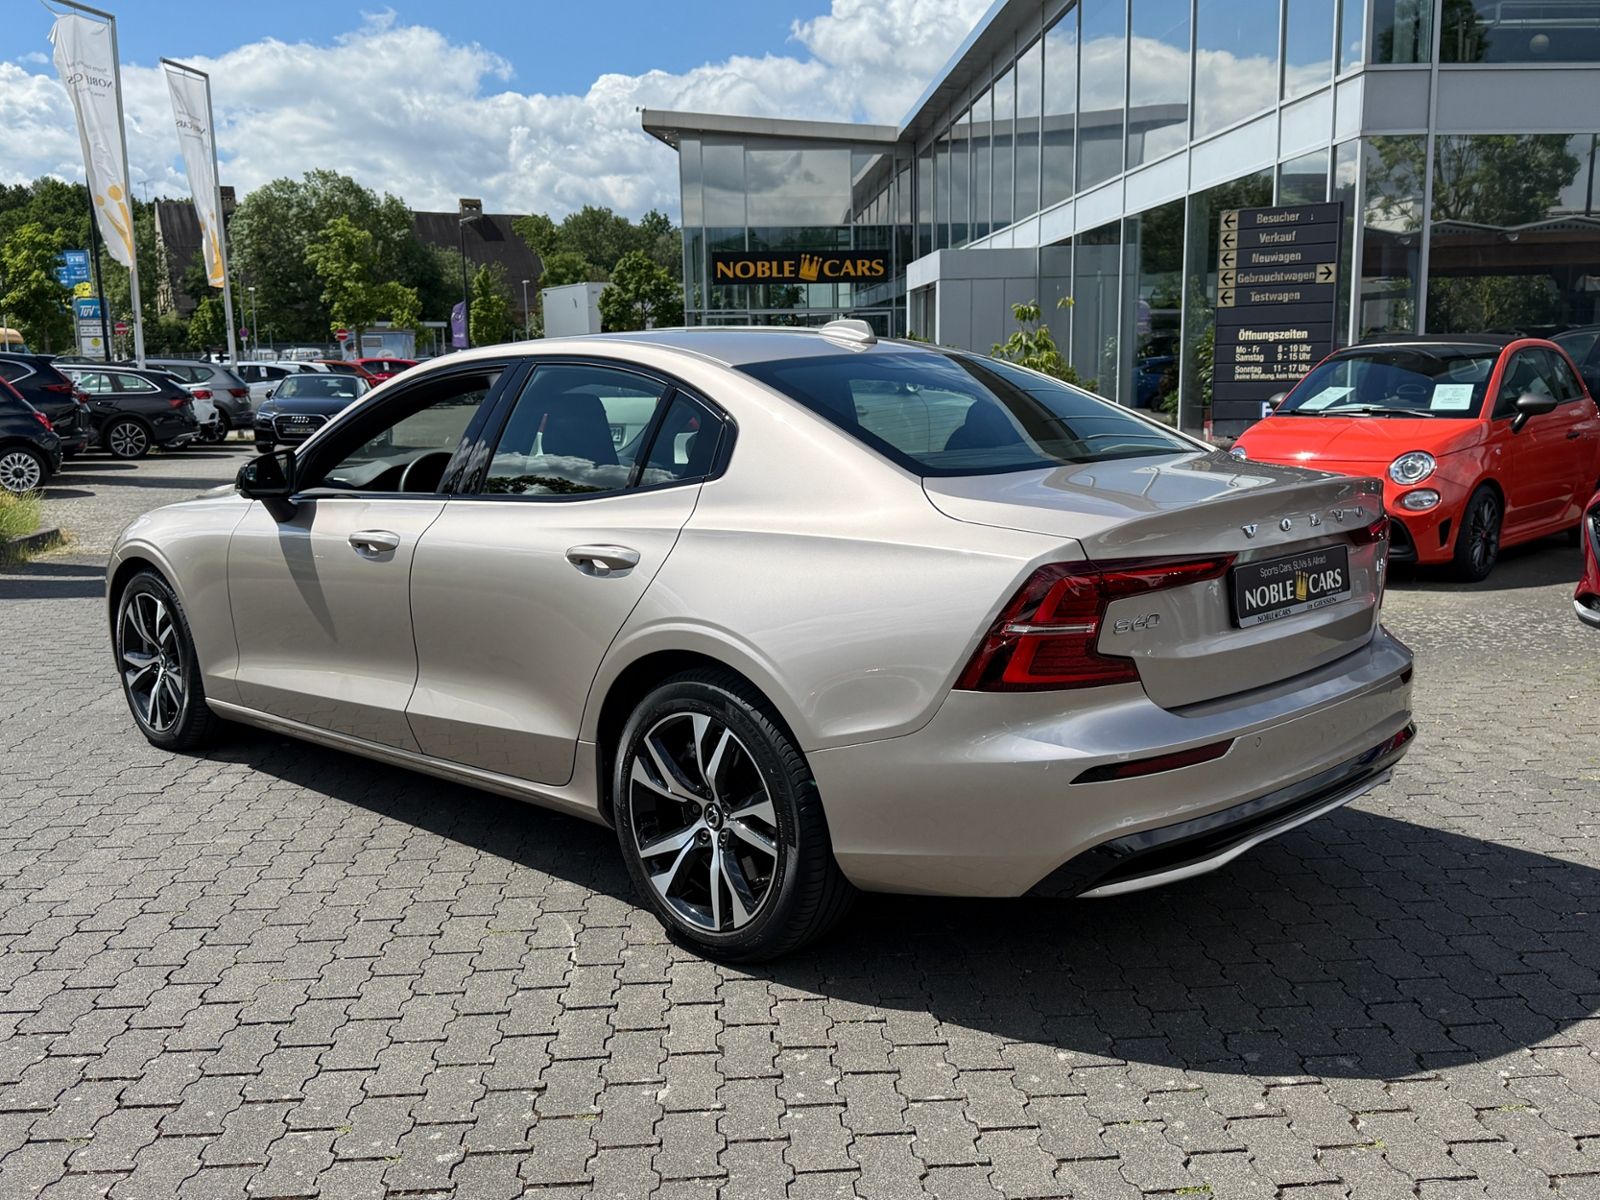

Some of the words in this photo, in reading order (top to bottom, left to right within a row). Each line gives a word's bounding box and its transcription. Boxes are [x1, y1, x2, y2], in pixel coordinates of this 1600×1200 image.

[1256, 211, 1300, 224] Besucher
[1259, 230, 1296, 244] Verkauf
[1252, 251, 1301, 264] Neuwagen
[716, 260, 796, 279] NOBLE
[822, 258, 885, 277] CARS
[1237, 270, 1315, 284] Gebrauchtwagen
[1250, 290, 1300, 303] Testwagen
[1238, 328, 1308, 341] Öffnungszeiten
[1299, 344, 1312, 352] Uhr
[1235, 353, 1264, 362] Samstag
[1289, 364, 1297, 372] 17
[1240, 506, 1364, 539] VOLVO
[1259, 565, 1279, 578] Sports
[1245, 580, 1294, 610] NOBLE
[1308, 568, 1342, 593] CARS
[1278, 608, 1292, 617] CARS
[1113, 613, 1161, 635] S60
